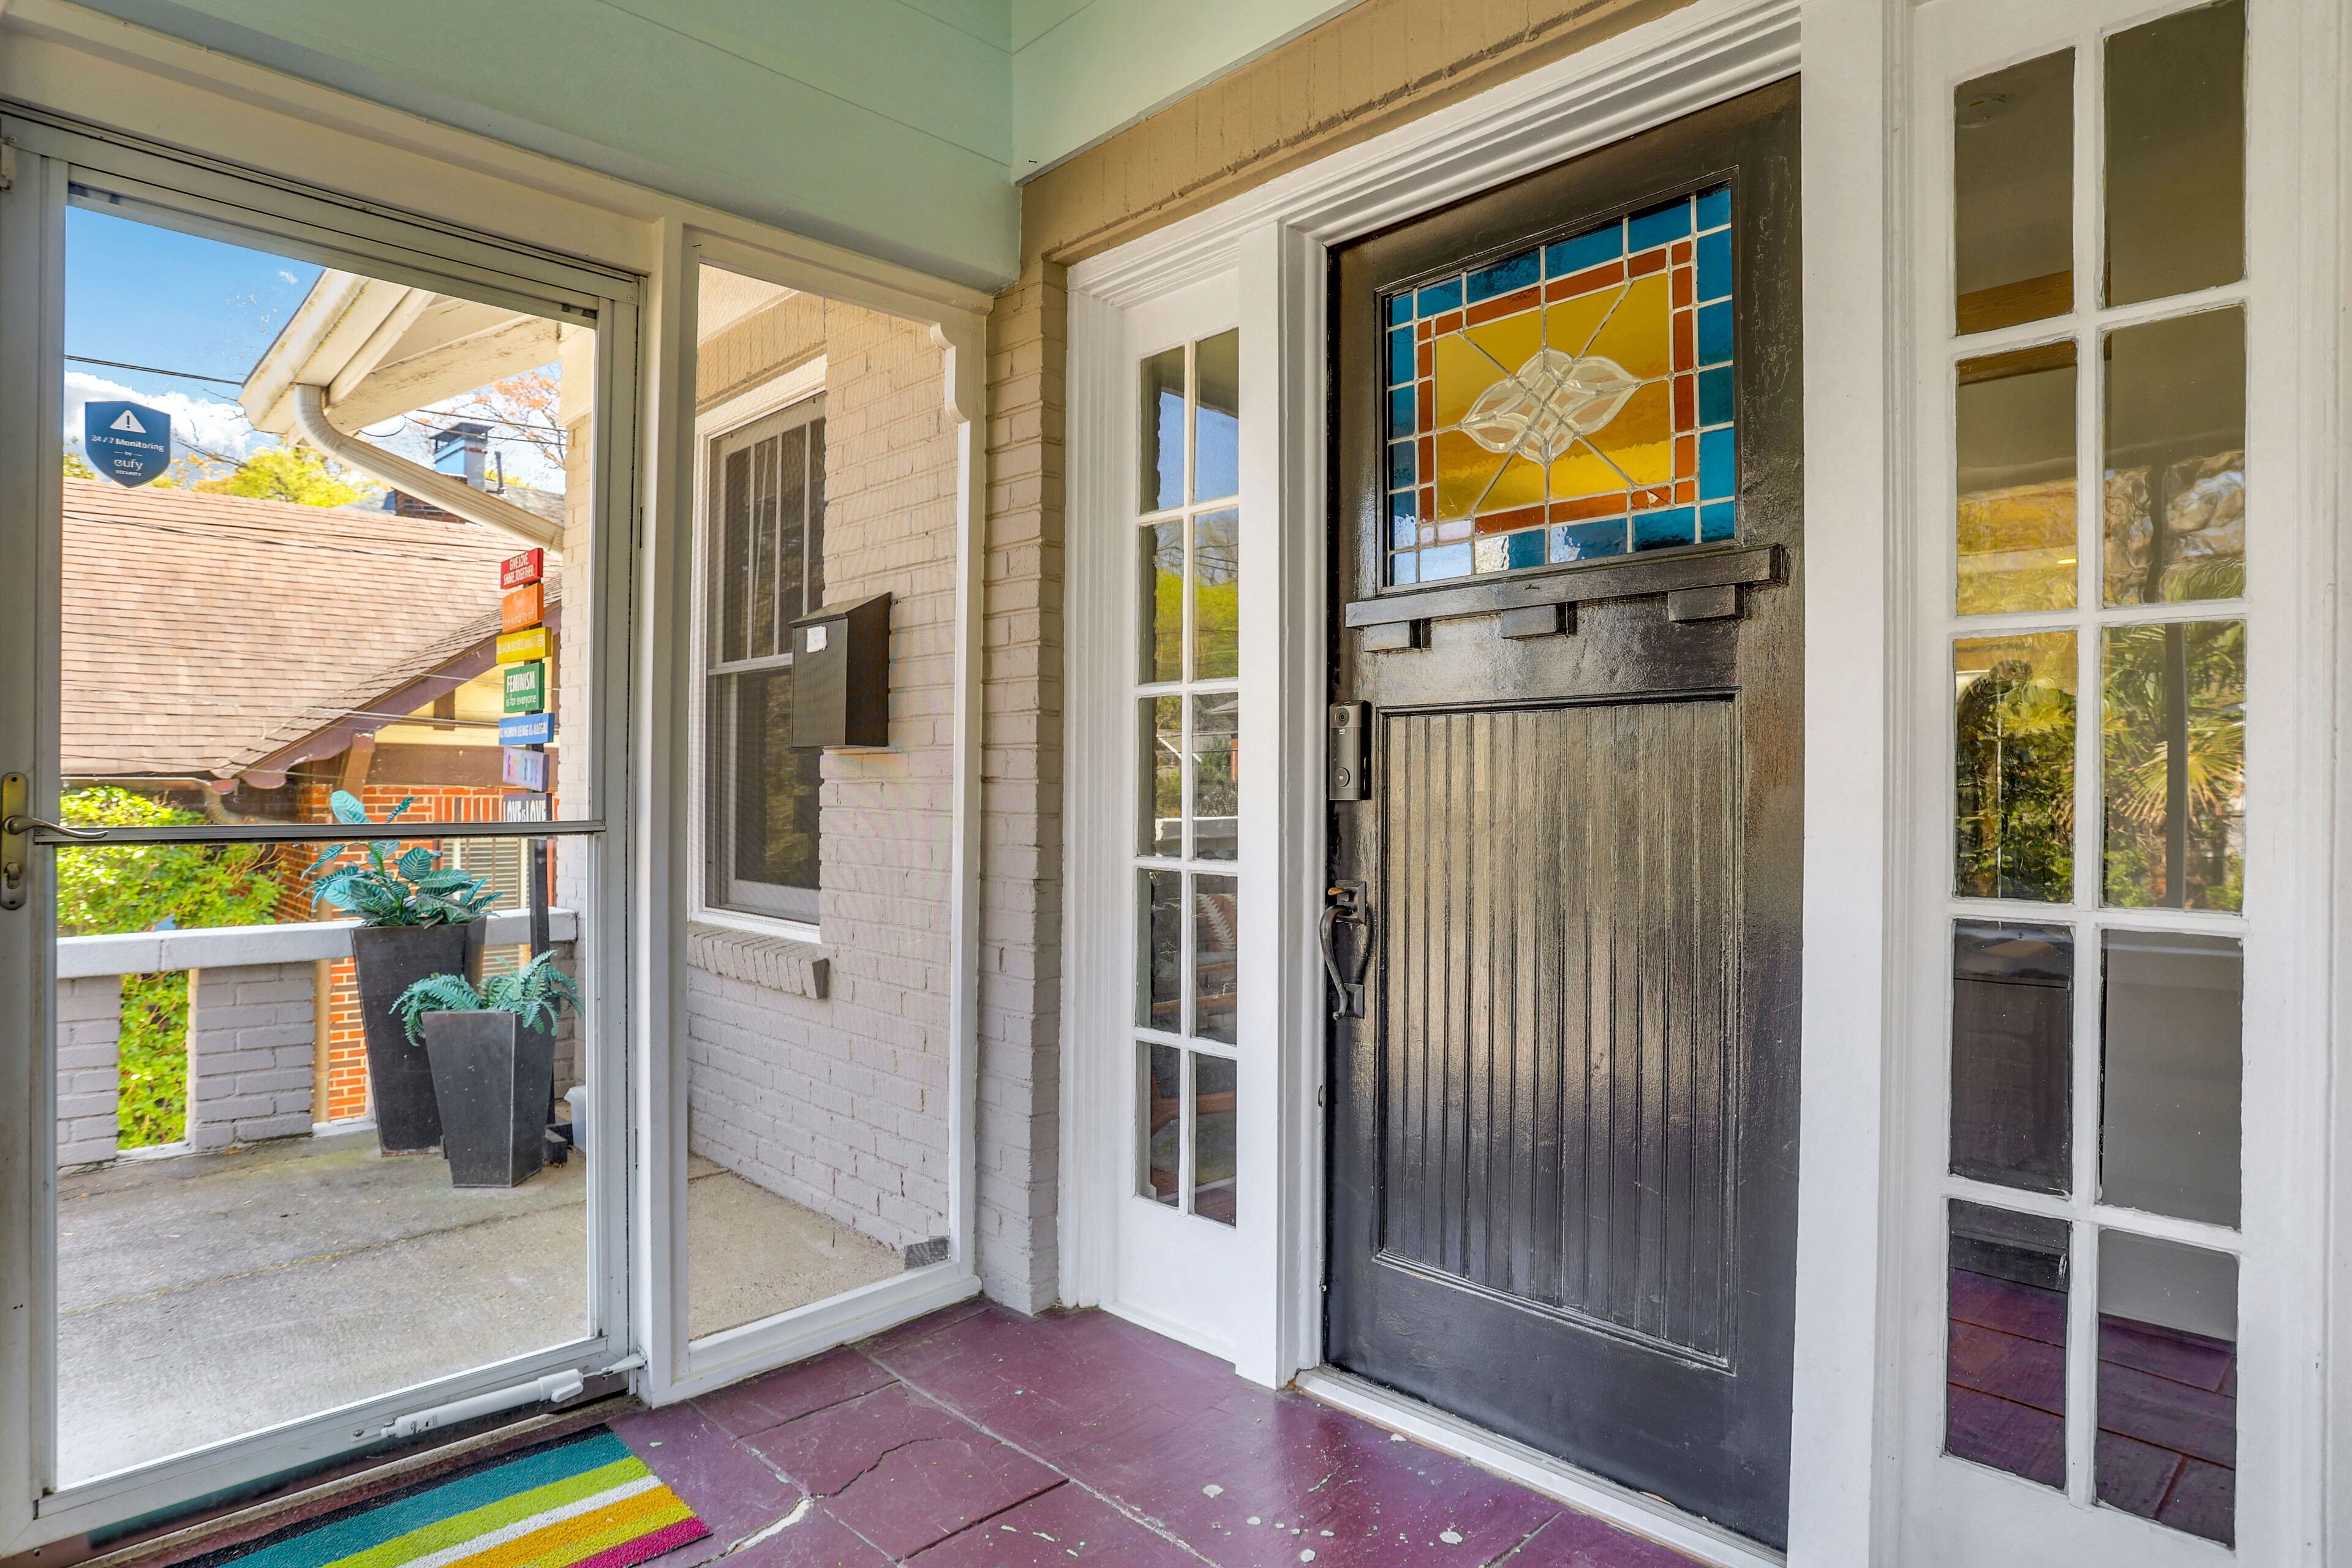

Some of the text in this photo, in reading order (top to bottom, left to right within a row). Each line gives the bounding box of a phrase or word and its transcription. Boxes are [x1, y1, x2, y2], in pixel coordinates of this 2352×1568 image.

[115, 439, 164, 452] Monitoring
[114, 459, 143, 471] eufy
[507, 671, 535, 693] FEMINISM
[505, 696, 509, 707] is
[517, 694, 536, 707] everyone
[504, 726, 517, 737] HUMAN
[518, 725, 529, 737] BEING
[529, 724, 533, 736] IS
[533, 722, 548, 736] ILLEGAL
[503, 800, 521, 822] LOVE
[526, 799, 546, 822] LOVE
